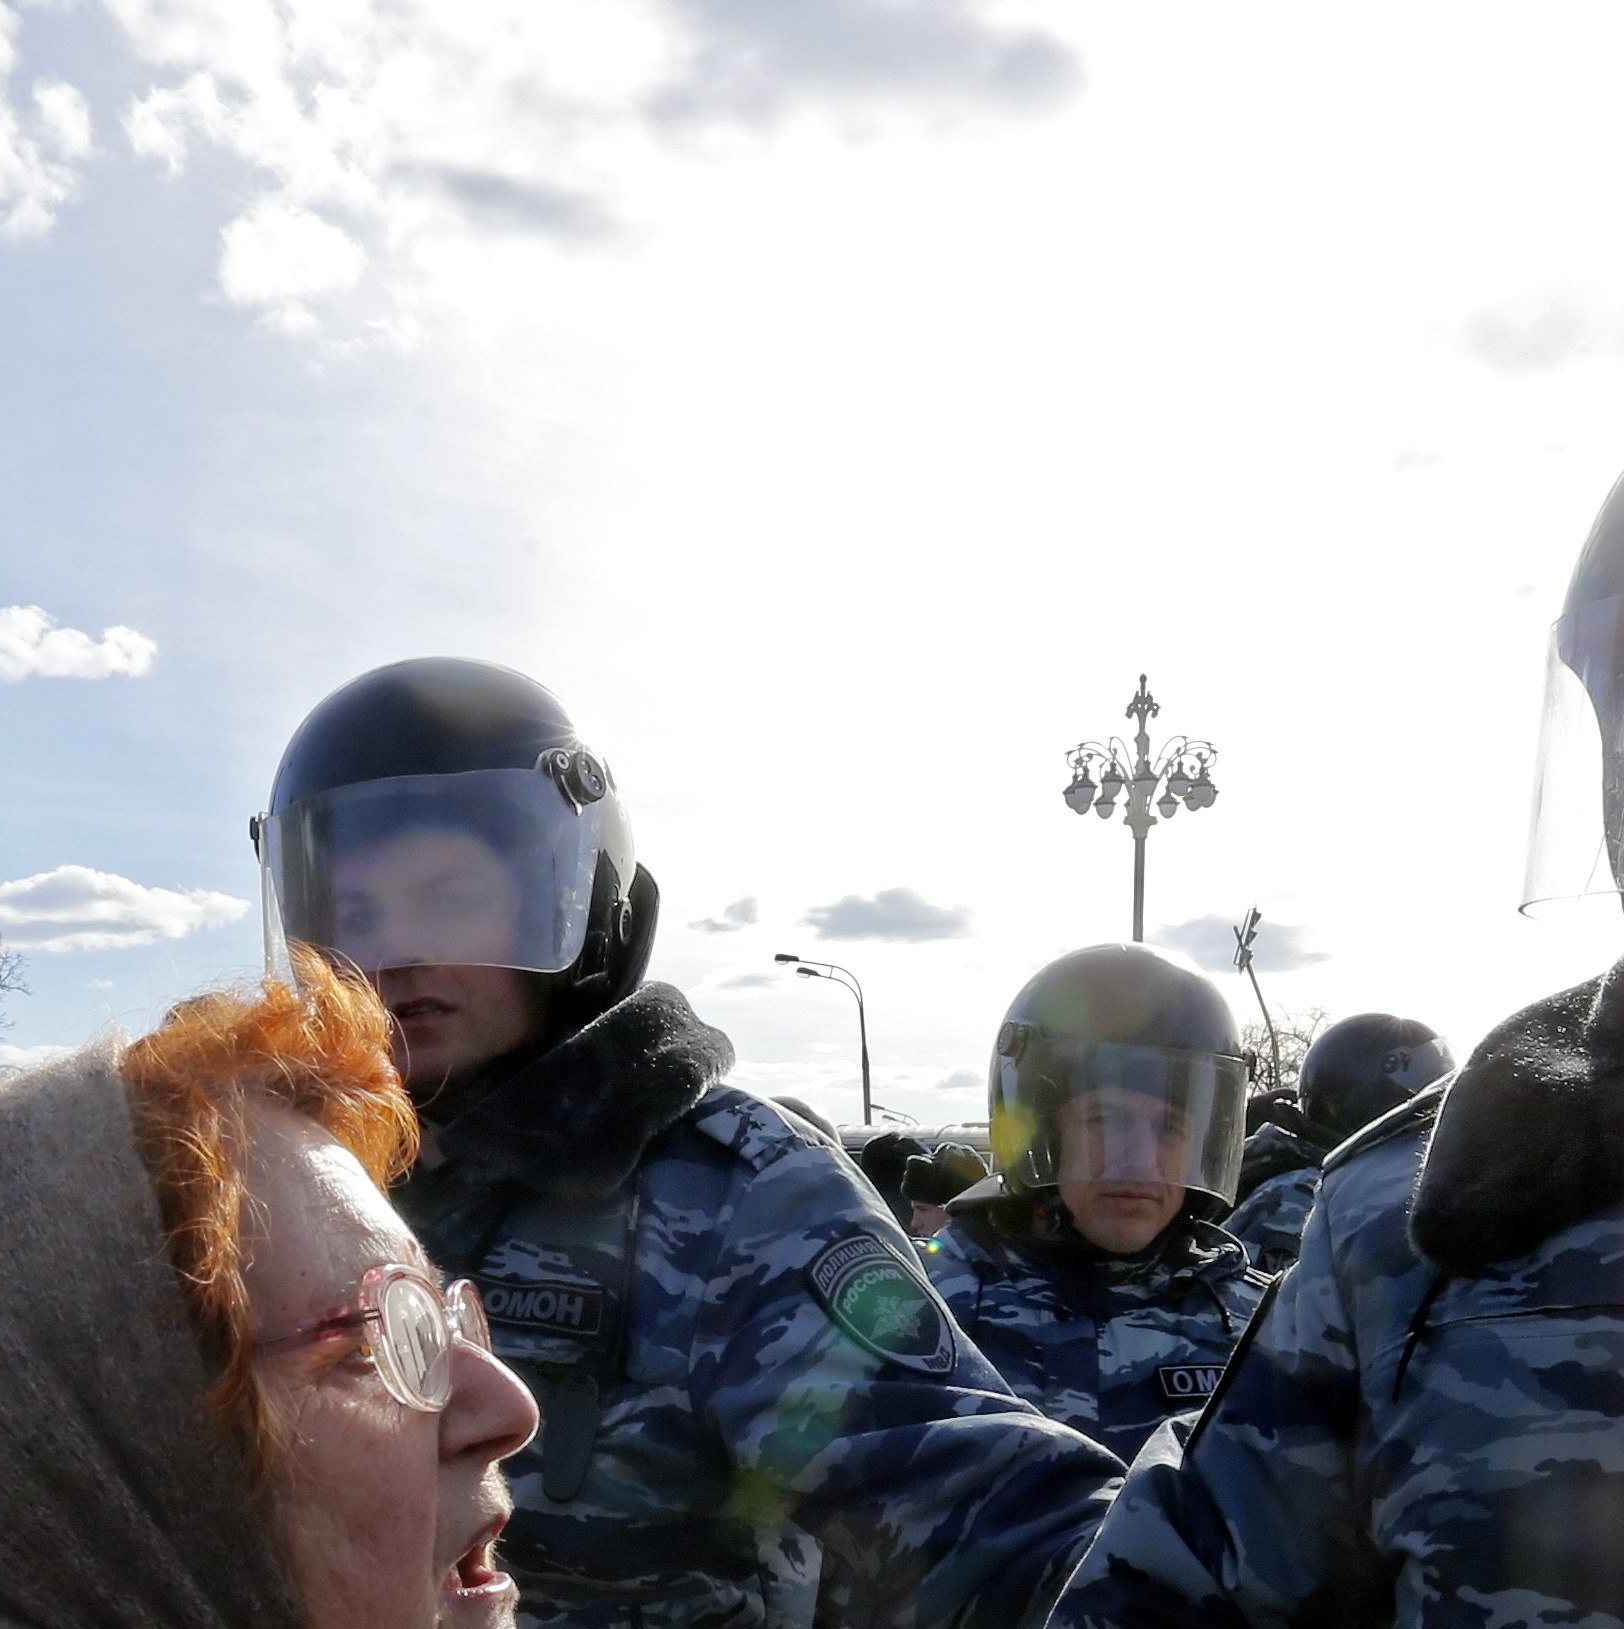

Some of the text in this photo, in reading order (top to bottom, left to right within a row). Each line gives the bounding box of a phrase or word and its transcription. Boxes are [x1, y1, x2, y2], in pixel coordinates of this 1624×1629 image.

[818, 1240, 885, 1288] ПОЛИЦИЯ
[483, 1287, 584, 1327] ОМОН
[843, 1267, 904, 1315] РОССИЯ
[1172, 1368, 1222, 1394] ОМ
